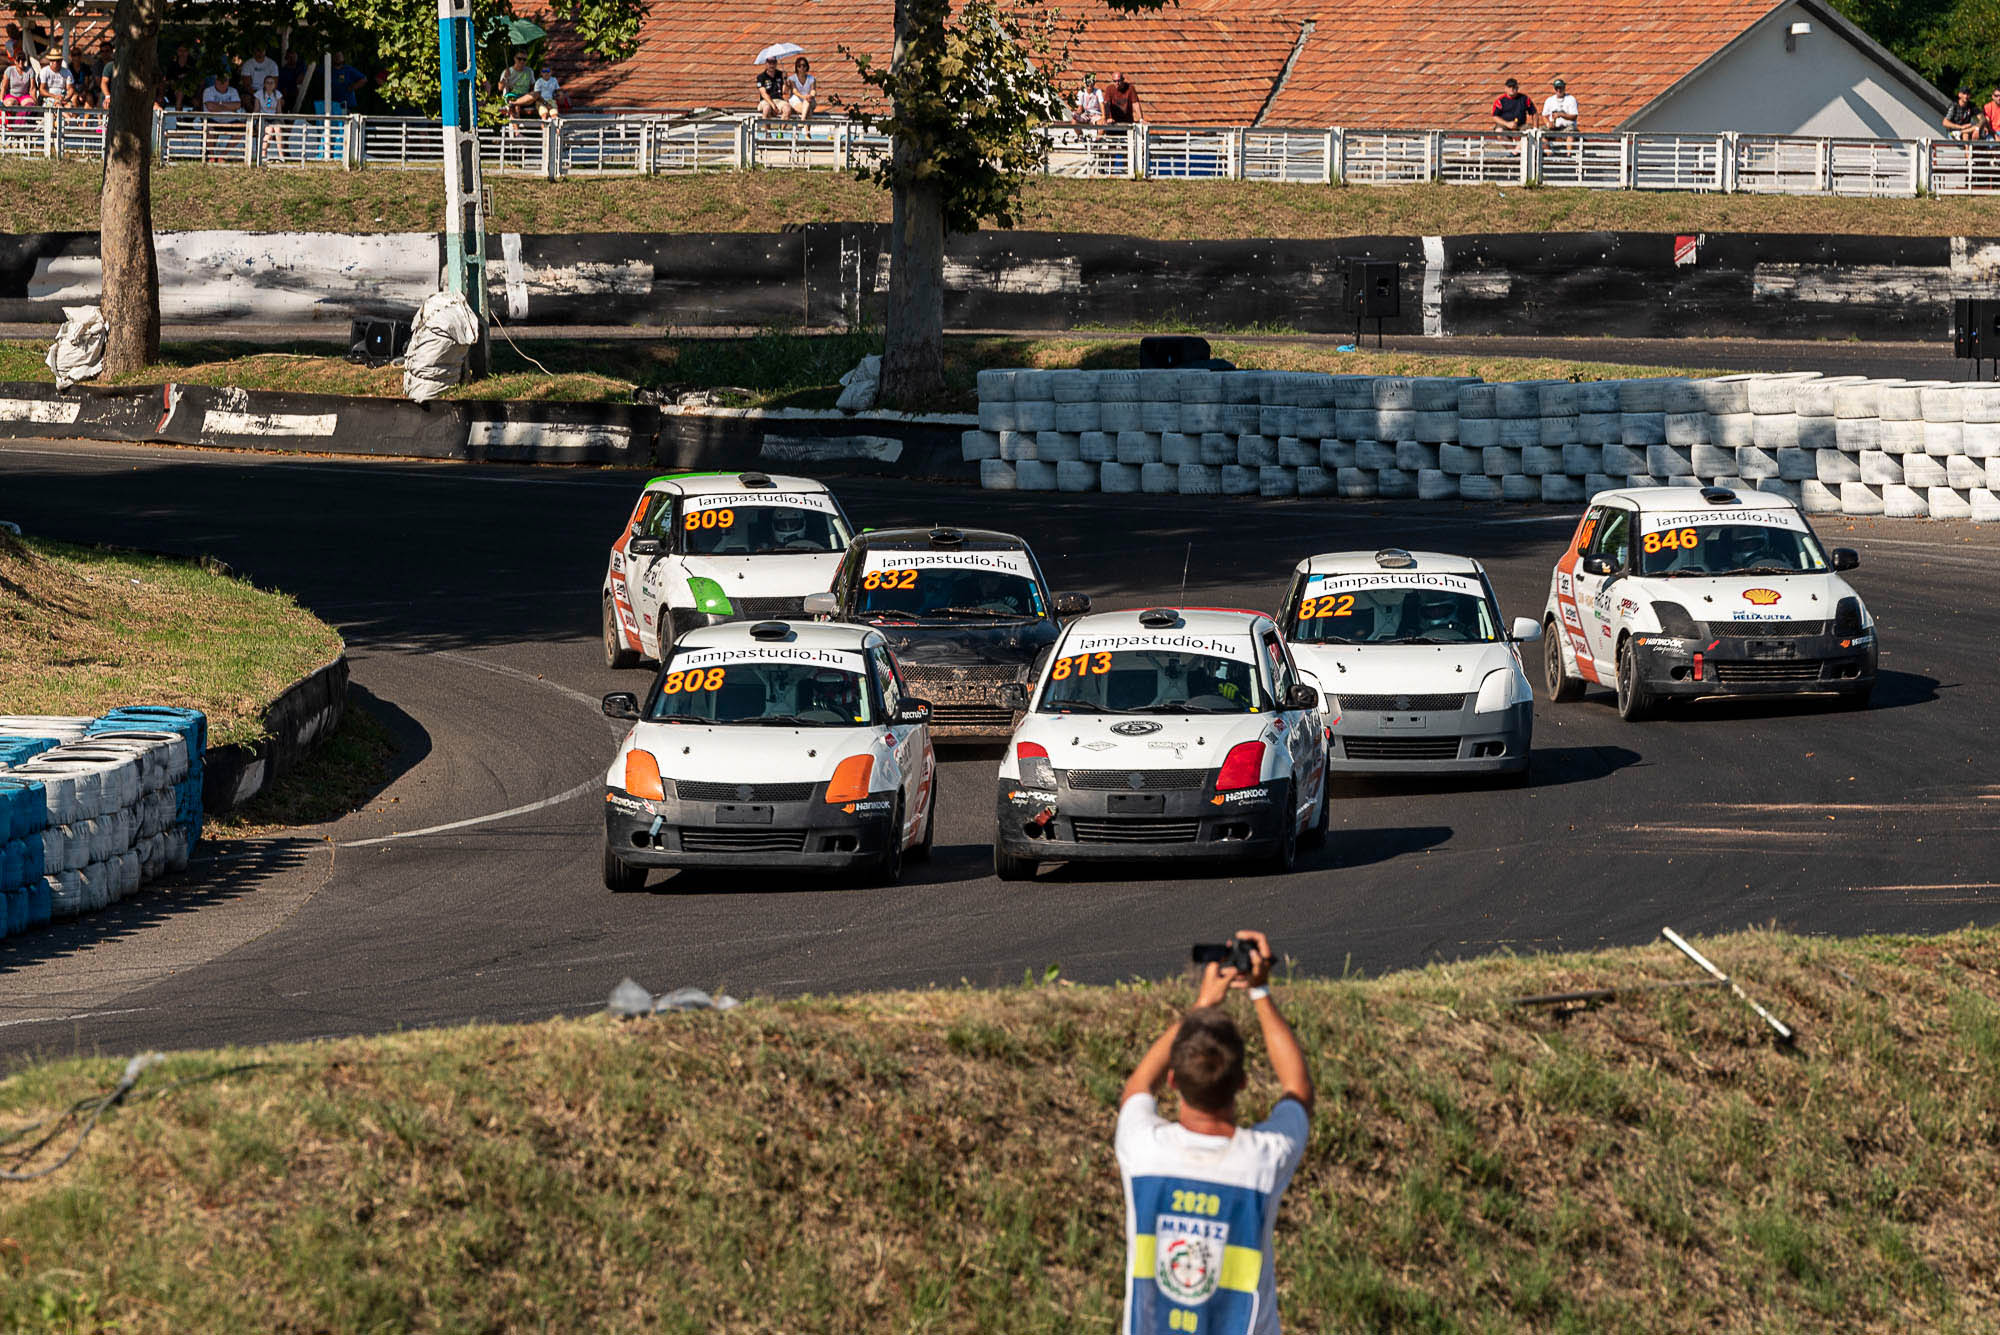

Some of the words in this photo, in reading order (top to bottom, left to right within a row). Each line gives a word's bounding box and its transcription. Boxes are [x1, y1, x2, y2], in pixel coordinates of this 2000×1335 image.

[698, 493, 823, 508] lampastudio.hu
[684, 508, 735, 531] 809
[1656, 511, 1789, 527] lampastudio.hu
[1643, 528, 1699, 554] 846
[882, 554, 1018, 571] lampastudio.hu
[863, 568, 918, 590] 832
[1323, 573, 1467, 590] lampastudio.hu
[1297, 594, 1355, 620] 822
[1079, 634, 1236, 655] lampastudio.hu
[686, 648, 844, 665] lampastudio.hu
[1051, 651, 1113, 681] 813
[663, 667, 726, 695] 808
[1171, 1189, 1221, 1216] 2020
